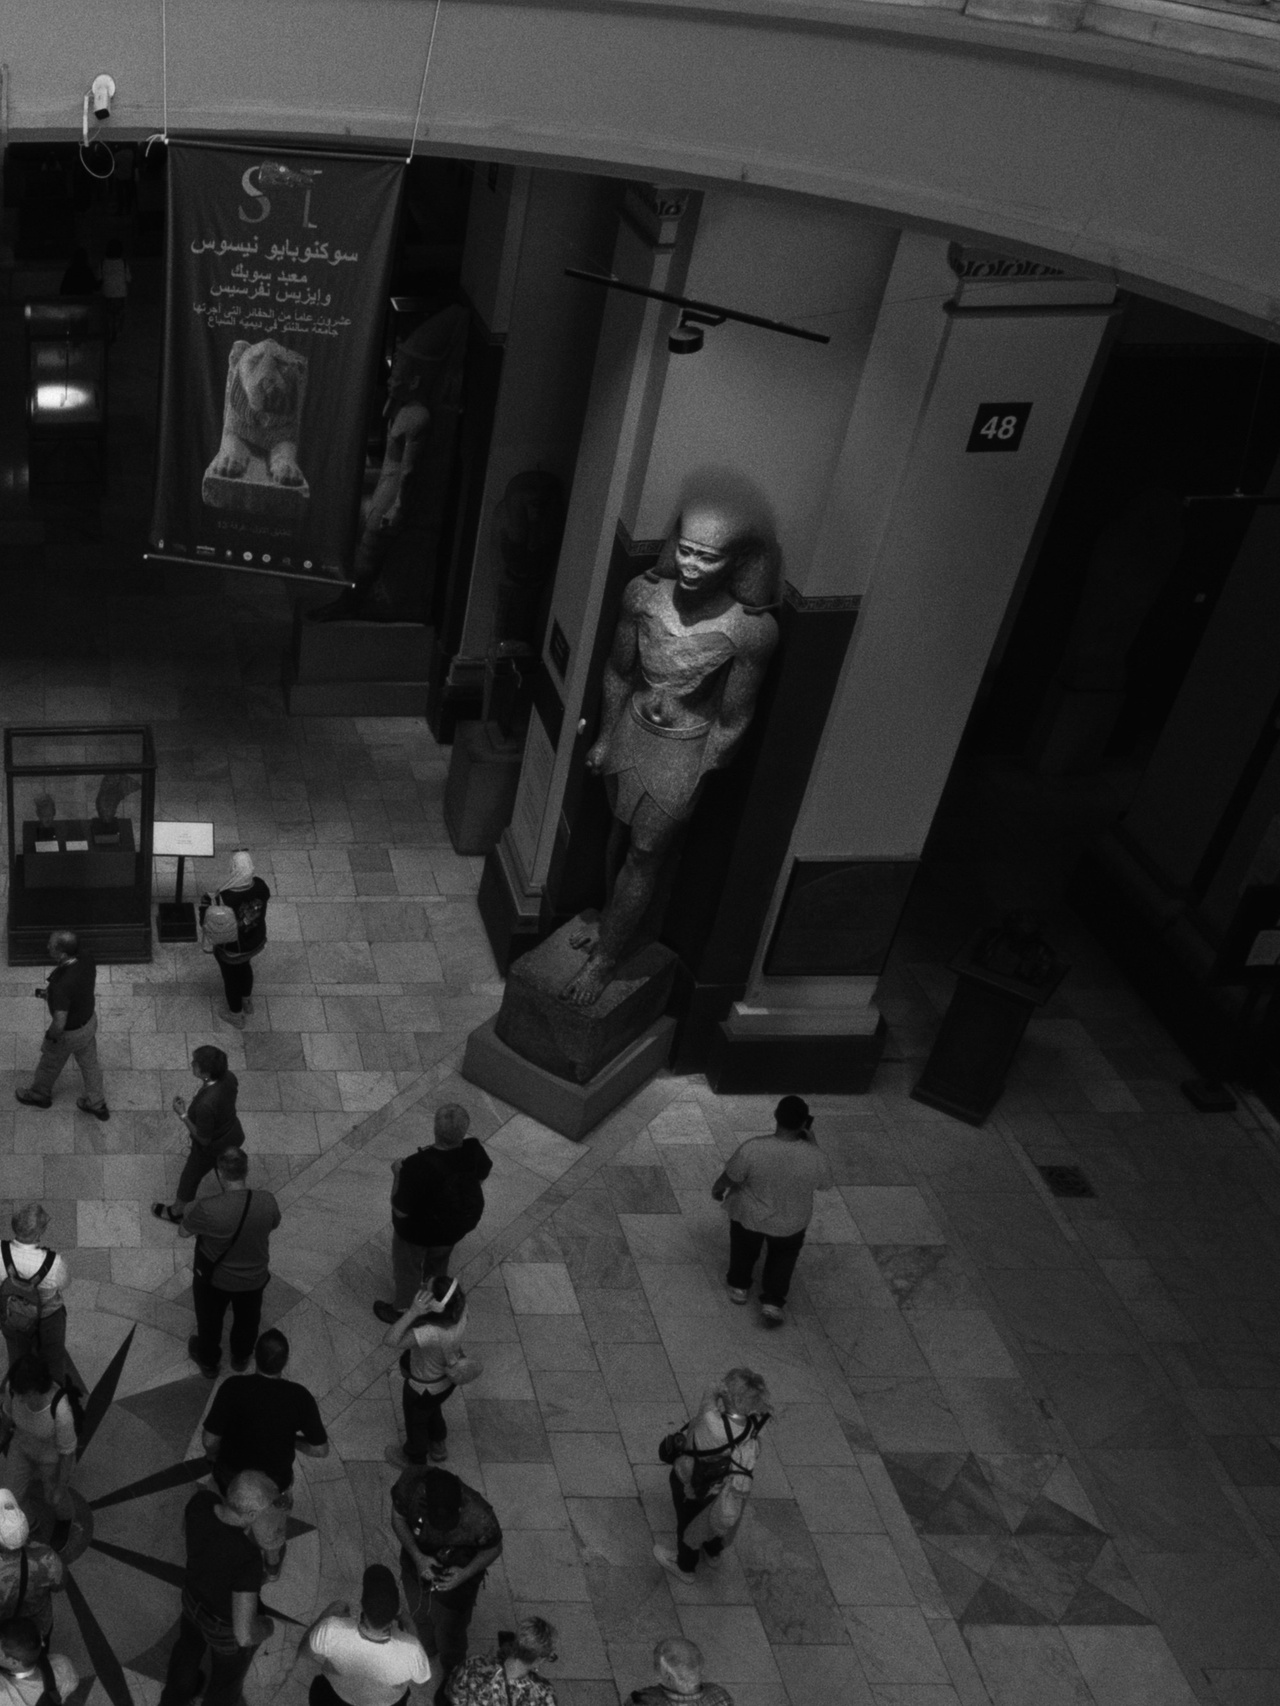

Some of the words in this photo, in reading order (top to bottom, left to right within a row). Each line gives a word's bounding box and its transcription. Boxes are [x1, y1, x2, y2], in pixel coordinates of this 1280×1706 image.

[189, 235, 259, 258] نيسوس
[264, 237, 359, 267] سوكنوبايو
[230, 262, 272, 283] سوبك
[276, 269, 309, 287] معبد
[980, 415, 1018, 440] 48
